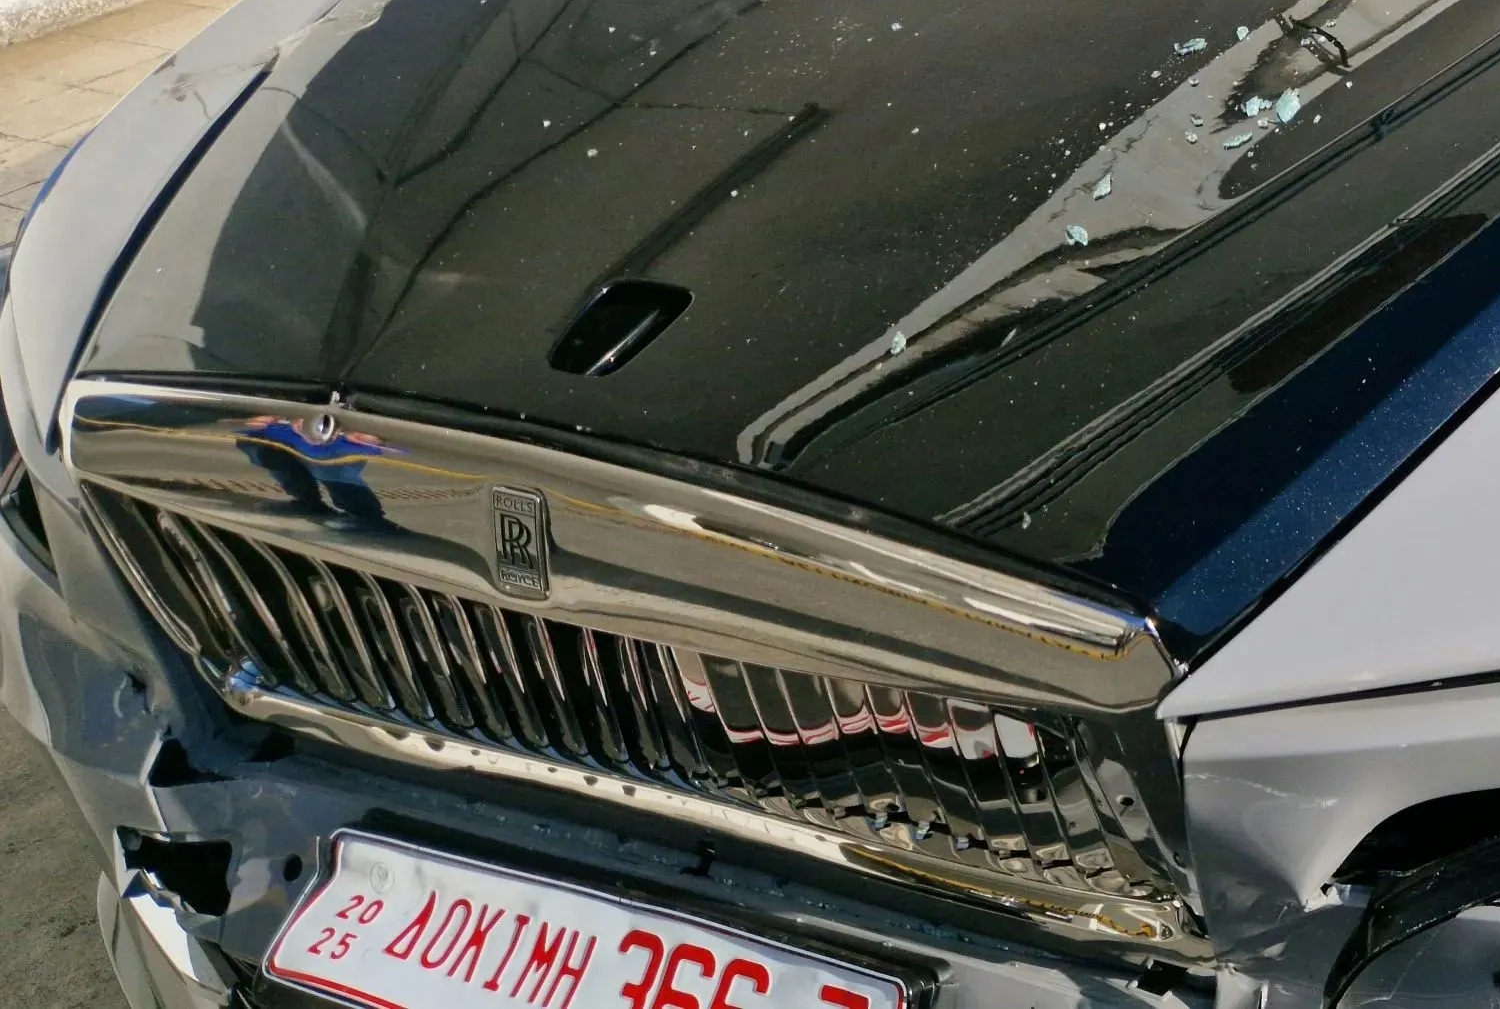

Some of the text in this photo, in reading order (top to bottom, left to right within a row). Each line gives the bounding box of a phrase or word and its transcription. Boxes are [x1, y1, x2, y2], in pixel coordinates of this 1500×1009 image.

[495, 495, 533, 513] ROLLS
[500, 514, 534, 569] RR
[501, 568, 540, 587] ROYCE
[335, 894, 385, 925] 20
[307, 927, 359, 960] 25
[384, 890, 598, 1009] ΔΟΚΙΜΗ
